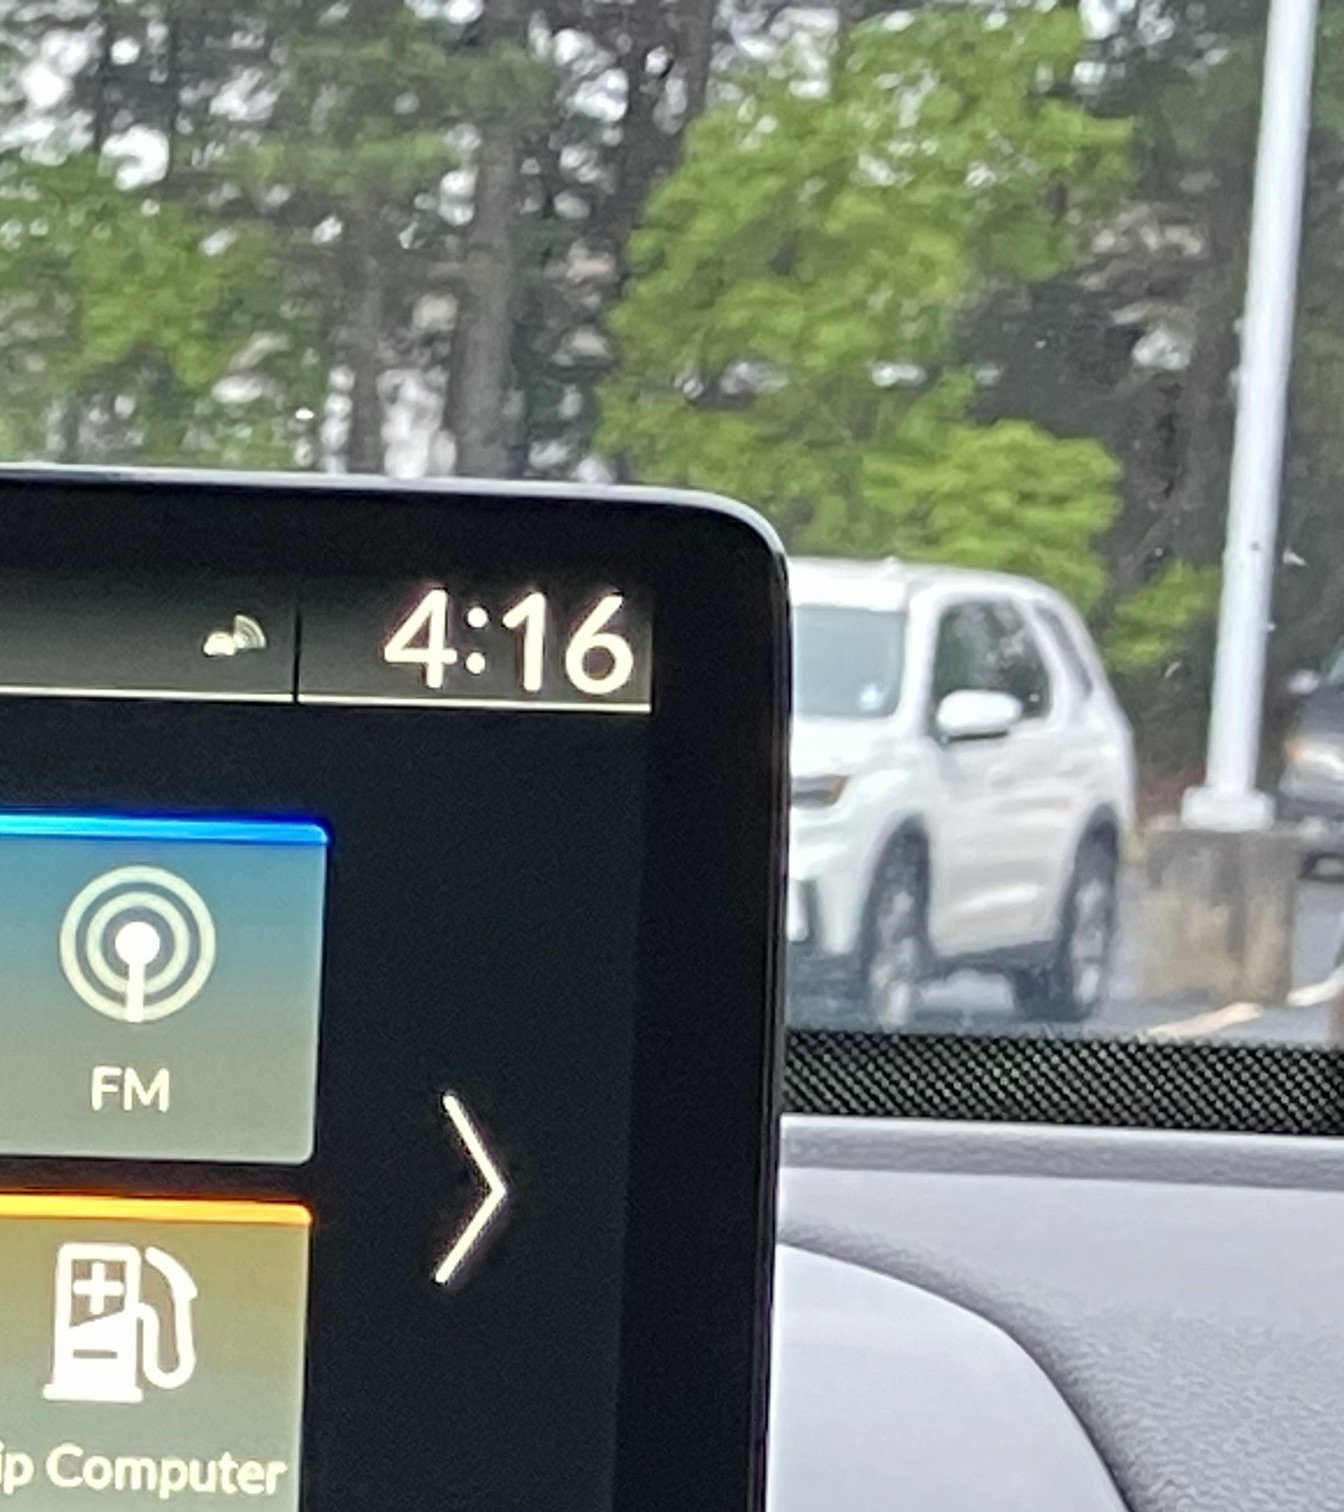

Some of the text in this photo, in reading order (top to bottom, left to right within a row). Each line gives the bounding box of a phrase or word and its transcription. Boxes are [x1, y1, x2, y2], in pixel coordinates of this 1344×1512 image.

[383, 588, 635, 695] 4:16
[91, 1065, 170, 1113] FM
[45, 1442, 288, 1500] Computer
